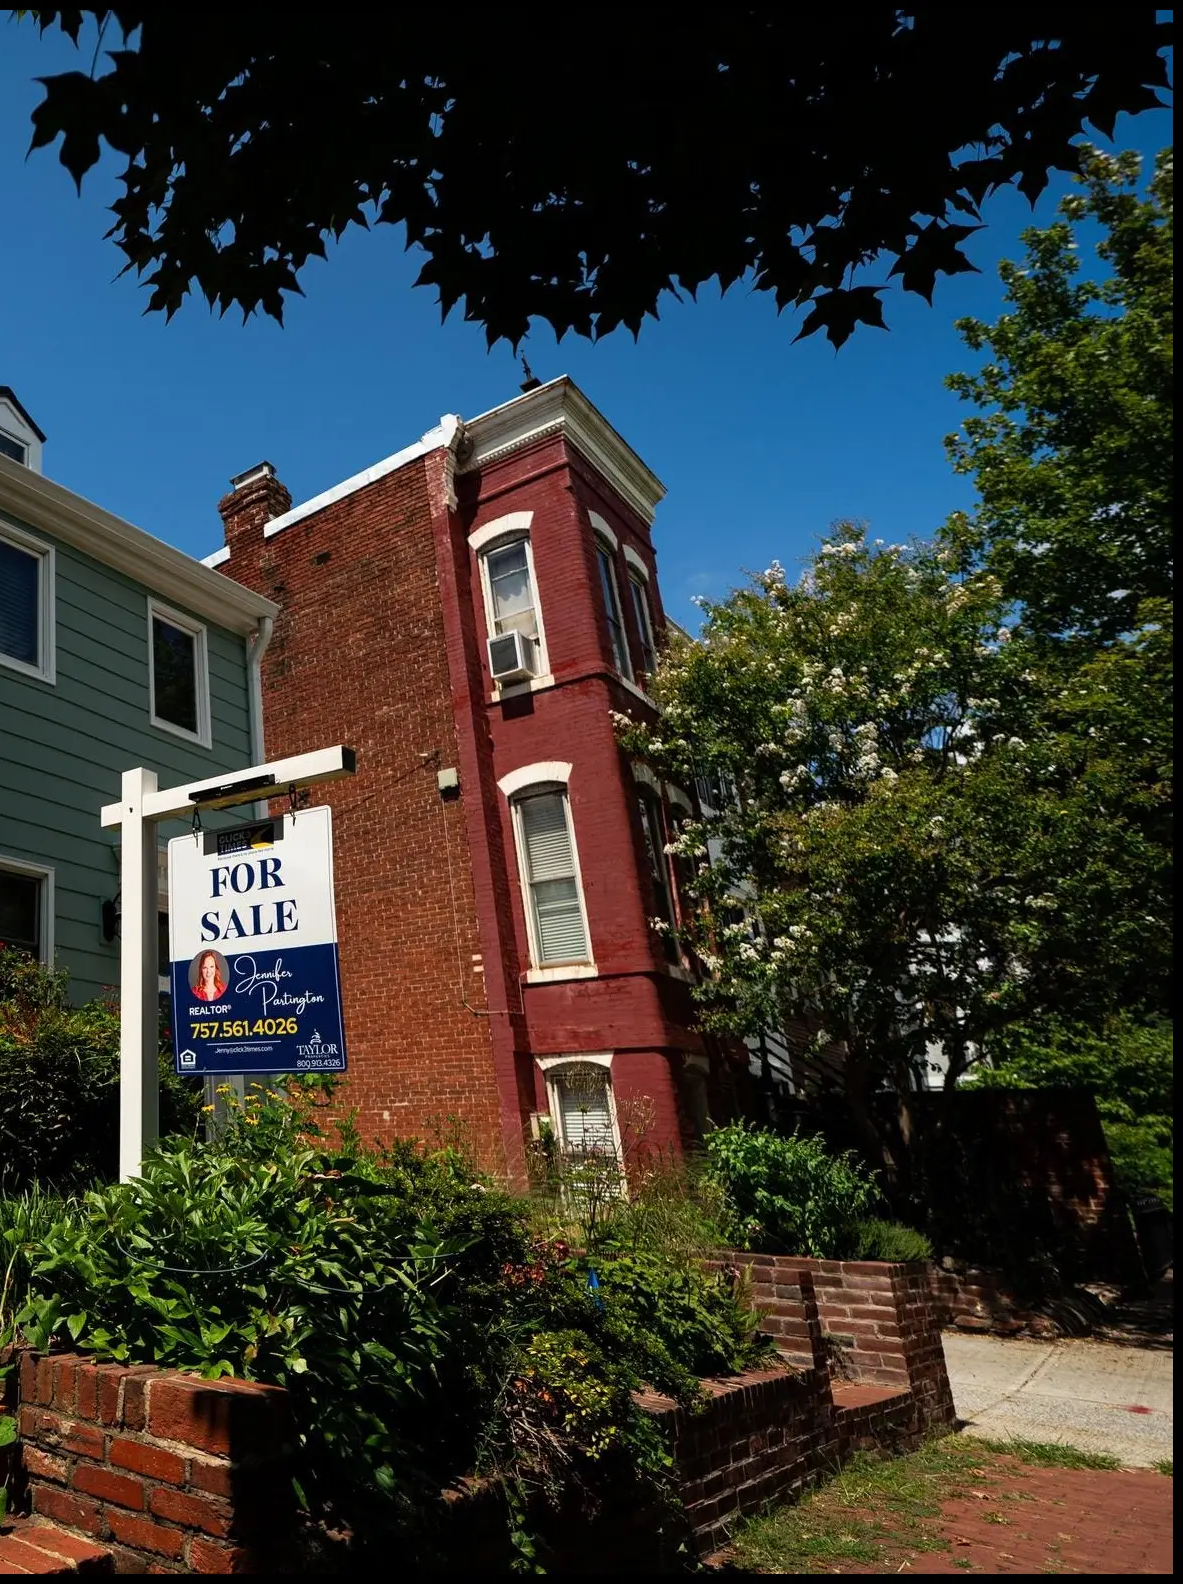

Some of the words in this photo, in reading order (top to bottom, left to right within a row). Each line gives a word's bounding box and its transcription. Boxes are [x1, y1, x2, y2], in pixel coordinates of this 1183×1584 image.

[209, 857, 286, 898] FOR
[200, 899, 299, 942] SALE
[234, 955, 293, 993] Jennifer
[249, 981, 324, 1017] Partington
[190, 1017, 298, 1039] 757.561.4026
[296, 1043, 339, 1055] TAYLOR
